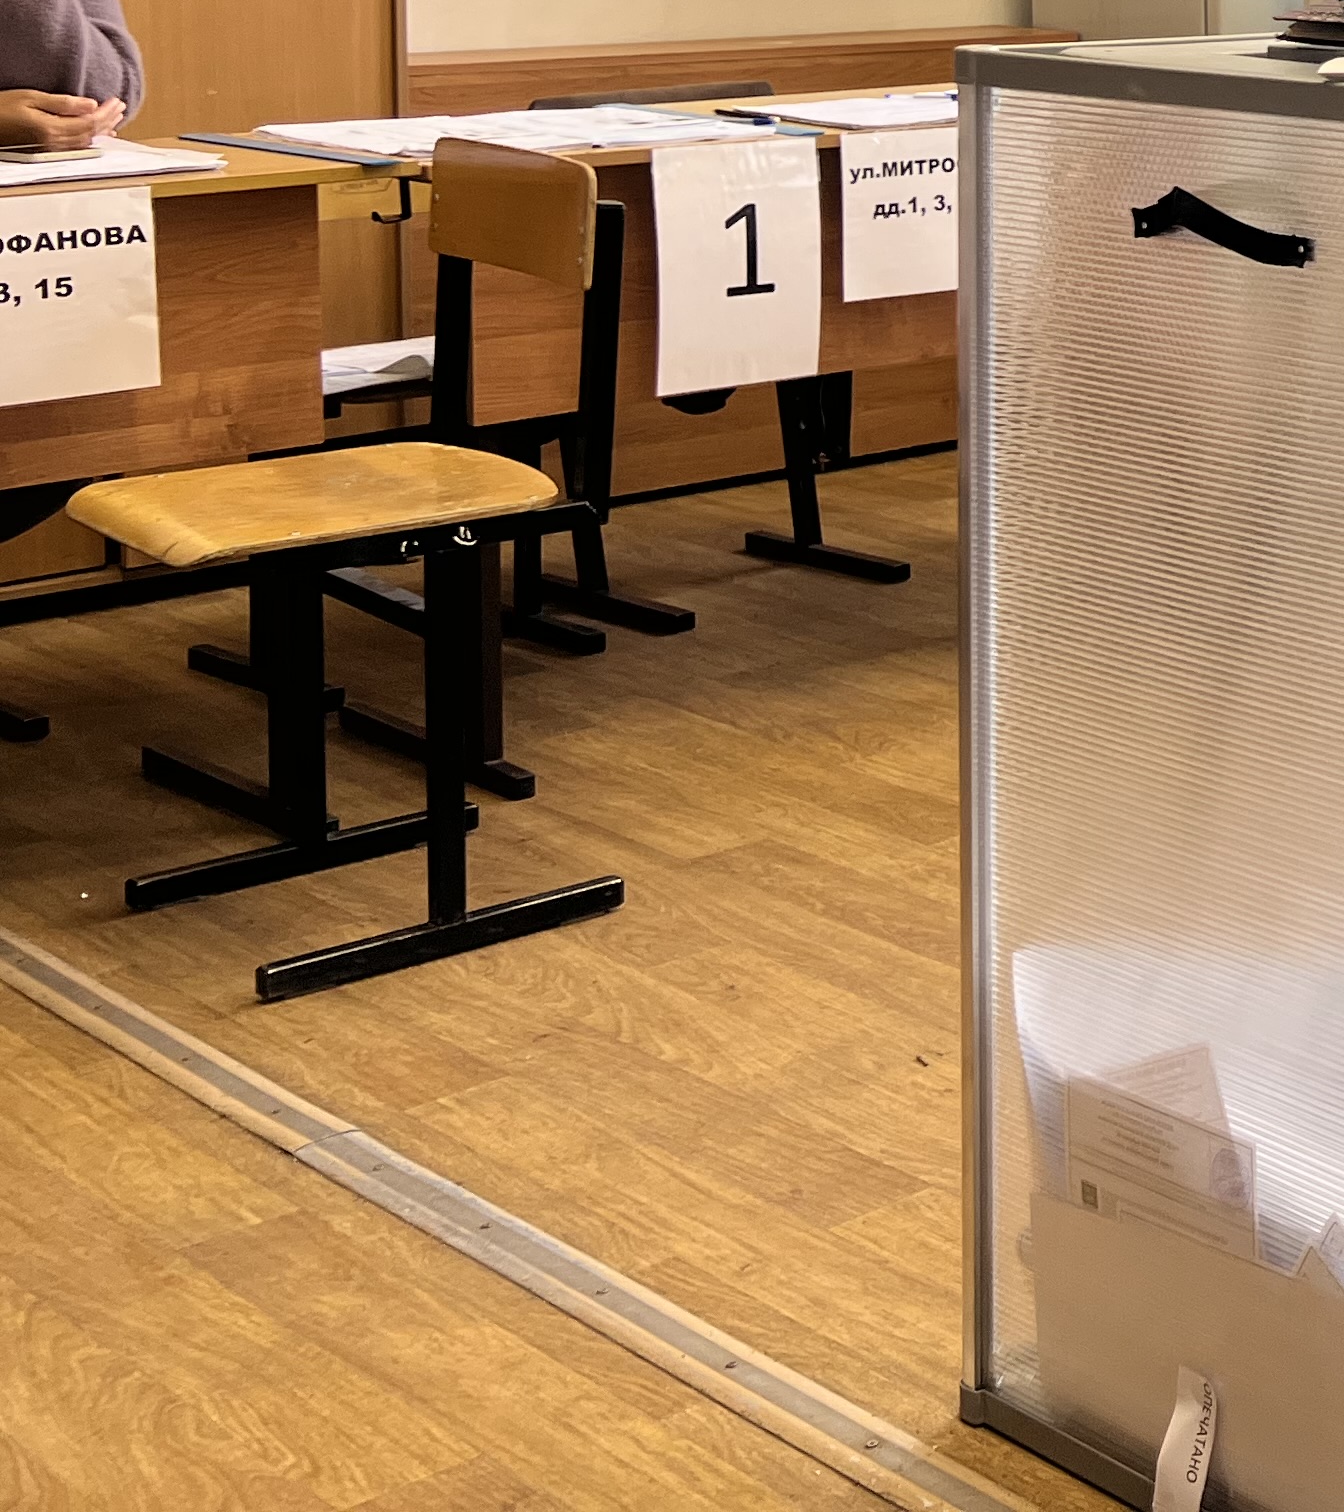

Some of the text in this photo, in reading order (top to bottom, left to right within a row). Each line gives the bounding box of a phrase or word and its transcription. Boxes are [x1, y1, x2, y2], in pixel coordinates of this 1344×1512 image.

[850, 157, 959, 184] ул.МИТРО
[933, 194, 952, 214] 3,
[0, 225, 147, 255] ФАНОВА
[724, 202, 775, 297] 1
[35, 276, 73, 299] 15
[1186, 1382, 1213, 1484] ОПЕЧАТАНО
